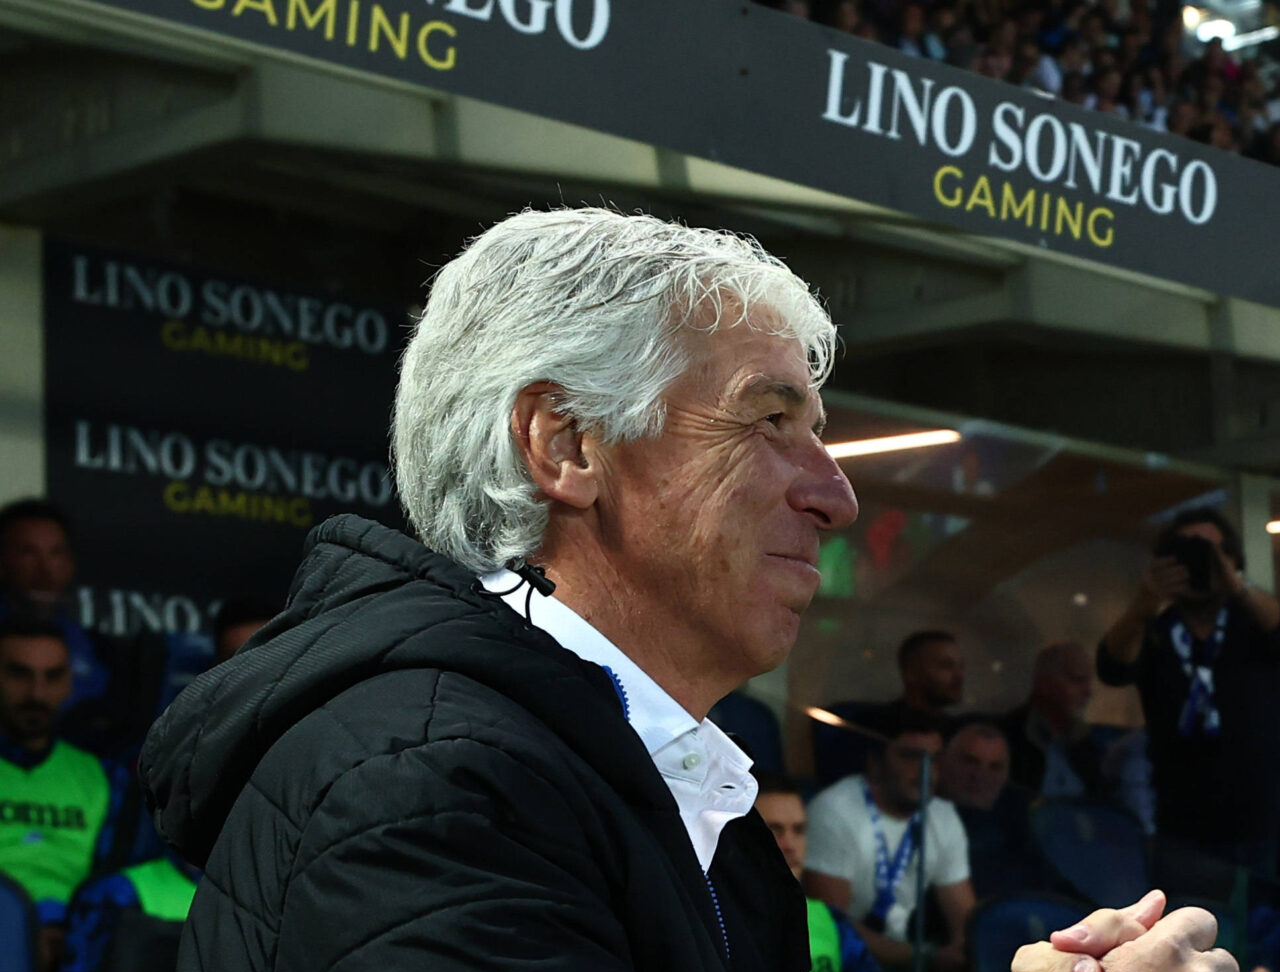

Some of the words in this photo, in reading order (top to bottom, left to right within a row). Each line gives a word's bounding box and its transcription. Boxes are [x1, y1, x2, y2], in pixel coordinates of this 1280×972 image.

[821, 49, 978, 157] LINO
[988, 102, 1218, 225] SONEGO
[933, 165, 1116, 248] GAMING
[74, 254, 193, 318] LINO
[202, 280, 389, 355] SONEGO
[160, 320, 309, 372] GAMING
[75, 420, 196, 480] LINO
[204, 439, 394, 506] SONEGO
[162, 481, 312, 527] GAMING
